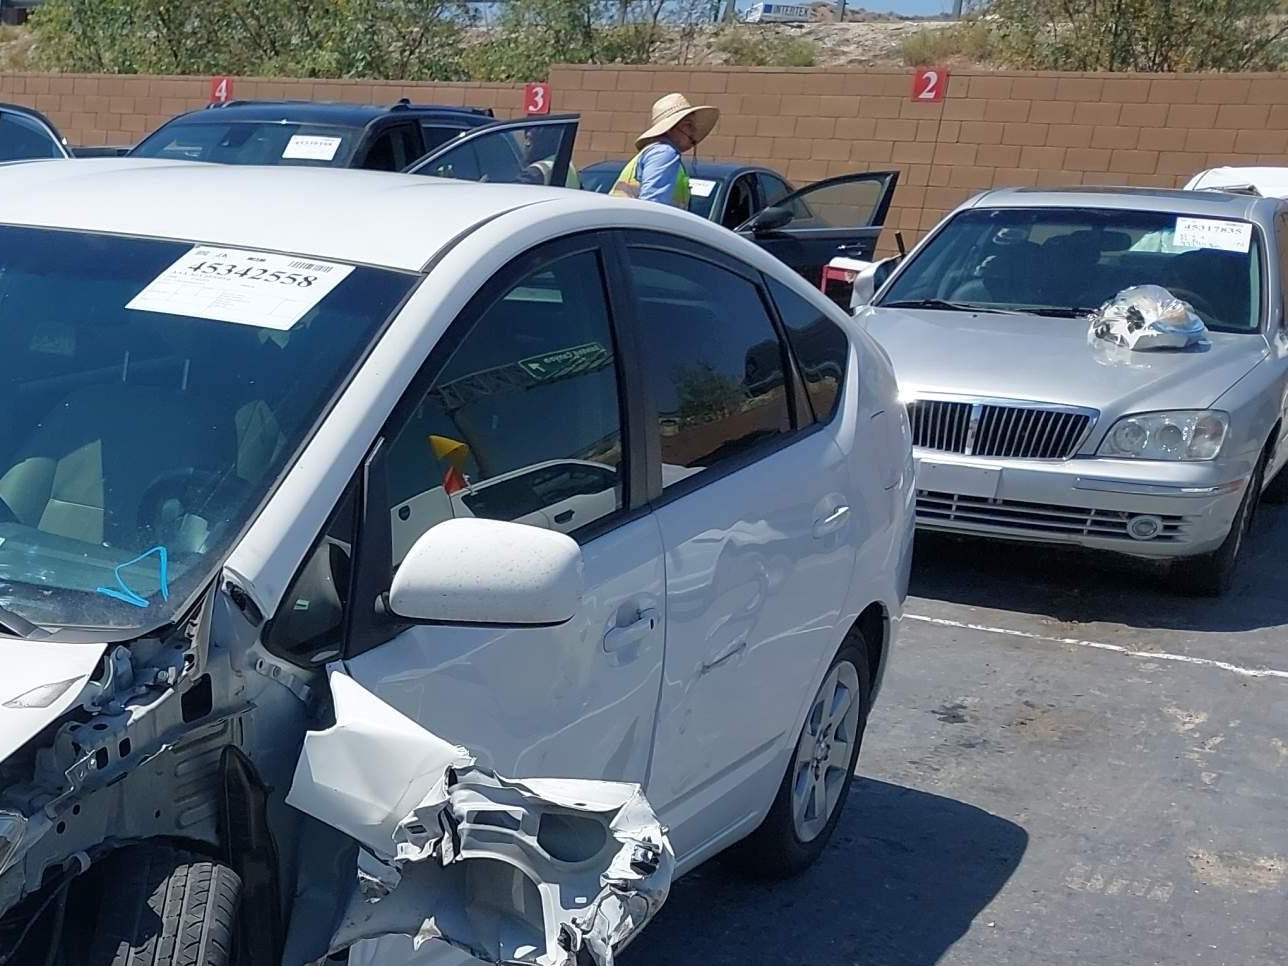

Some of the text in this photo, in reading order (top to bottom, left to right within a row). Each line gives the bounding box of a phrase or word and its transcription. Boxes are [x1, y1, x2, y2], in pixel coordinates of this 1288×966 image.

[215, 79, 228, 101] 4
[918, 71, 938, 99] 2
[528, 86, 544, 111] 3
[186, 261, 319, 289] 45342558
